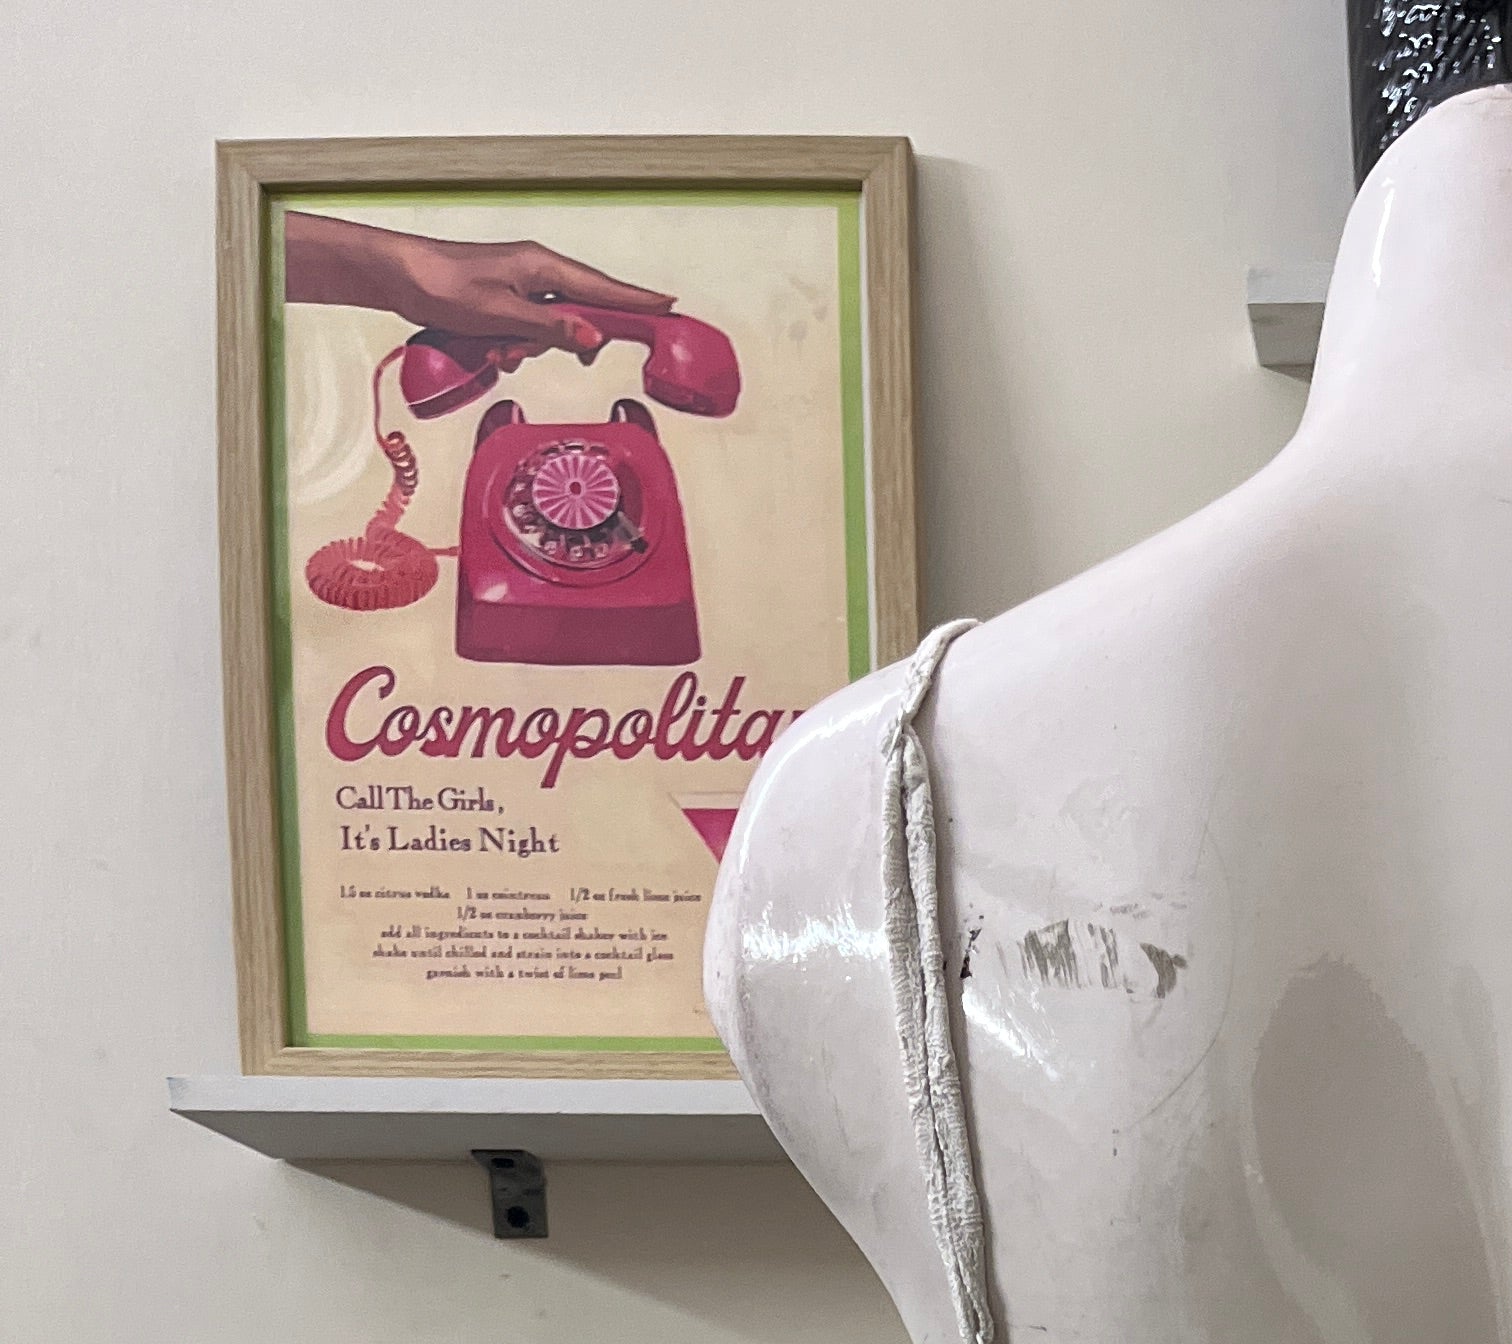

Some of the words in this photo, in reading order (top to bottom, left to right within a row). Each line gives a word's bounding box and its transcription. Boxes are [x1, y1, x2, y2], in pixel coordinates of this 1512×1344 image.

[336, 785, 385, 810] Call
[385, 785, 434, 811] The
[437, 786, 504, 815] Girls,
[340, 825, 380, 851] It's
[387, 825, 471, 852] Ladies
[479, 826, 560, 858] Night
